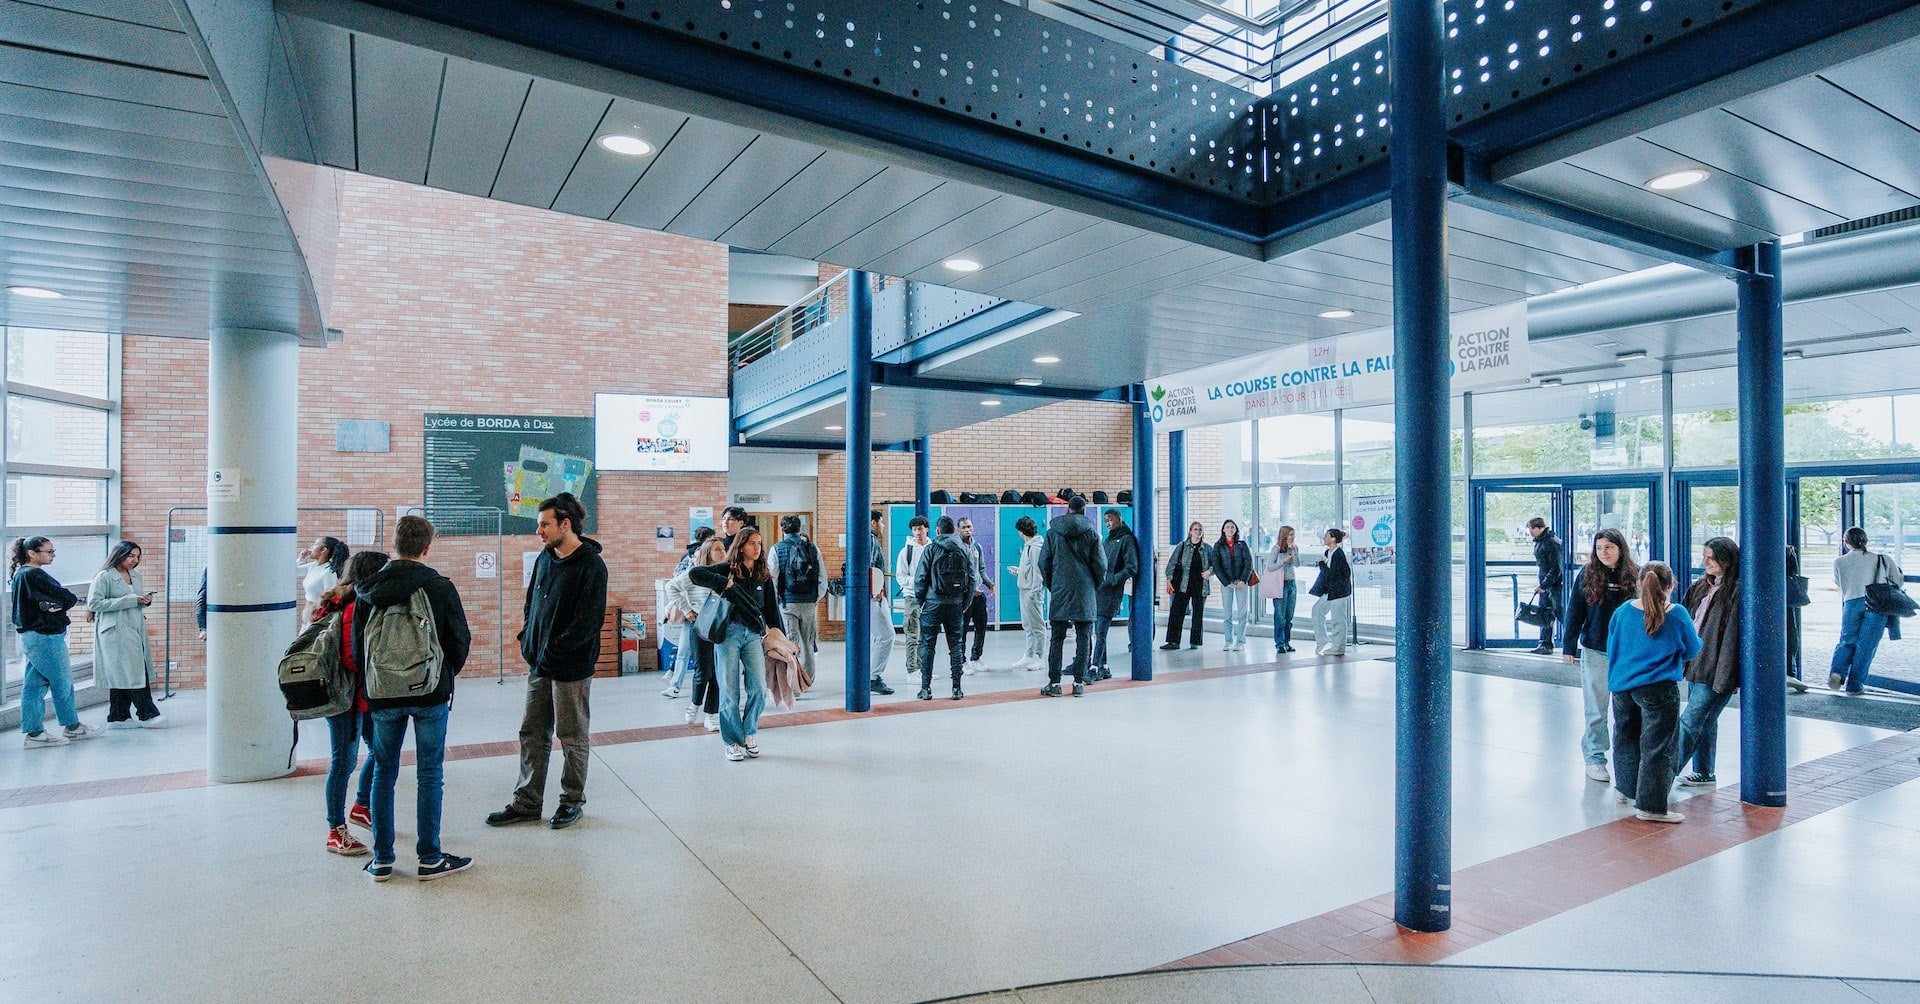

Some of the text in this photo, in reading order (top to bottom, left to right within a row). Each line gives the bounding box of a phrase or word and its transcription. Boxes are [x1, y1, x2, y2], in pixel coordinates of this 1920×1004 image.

[1457, 327, 1510, 347] ACTION
[1312, 346, 1330, 357] 12H
[1458, 341, 1510, 359] CONTRE
[1460, 353, 1510, 372] LA FAIM
[1207, 355, 1395, 401] LA COURSE CONTRE LA FAI
[1167, 386, 1195, 399] ACTION
[1166, 396, 1197, 408] CONTRE
[1165, 405, 1197, 418] LA FAIM
[424, 416, 555, 430] Lycée de BORDA à Dax
